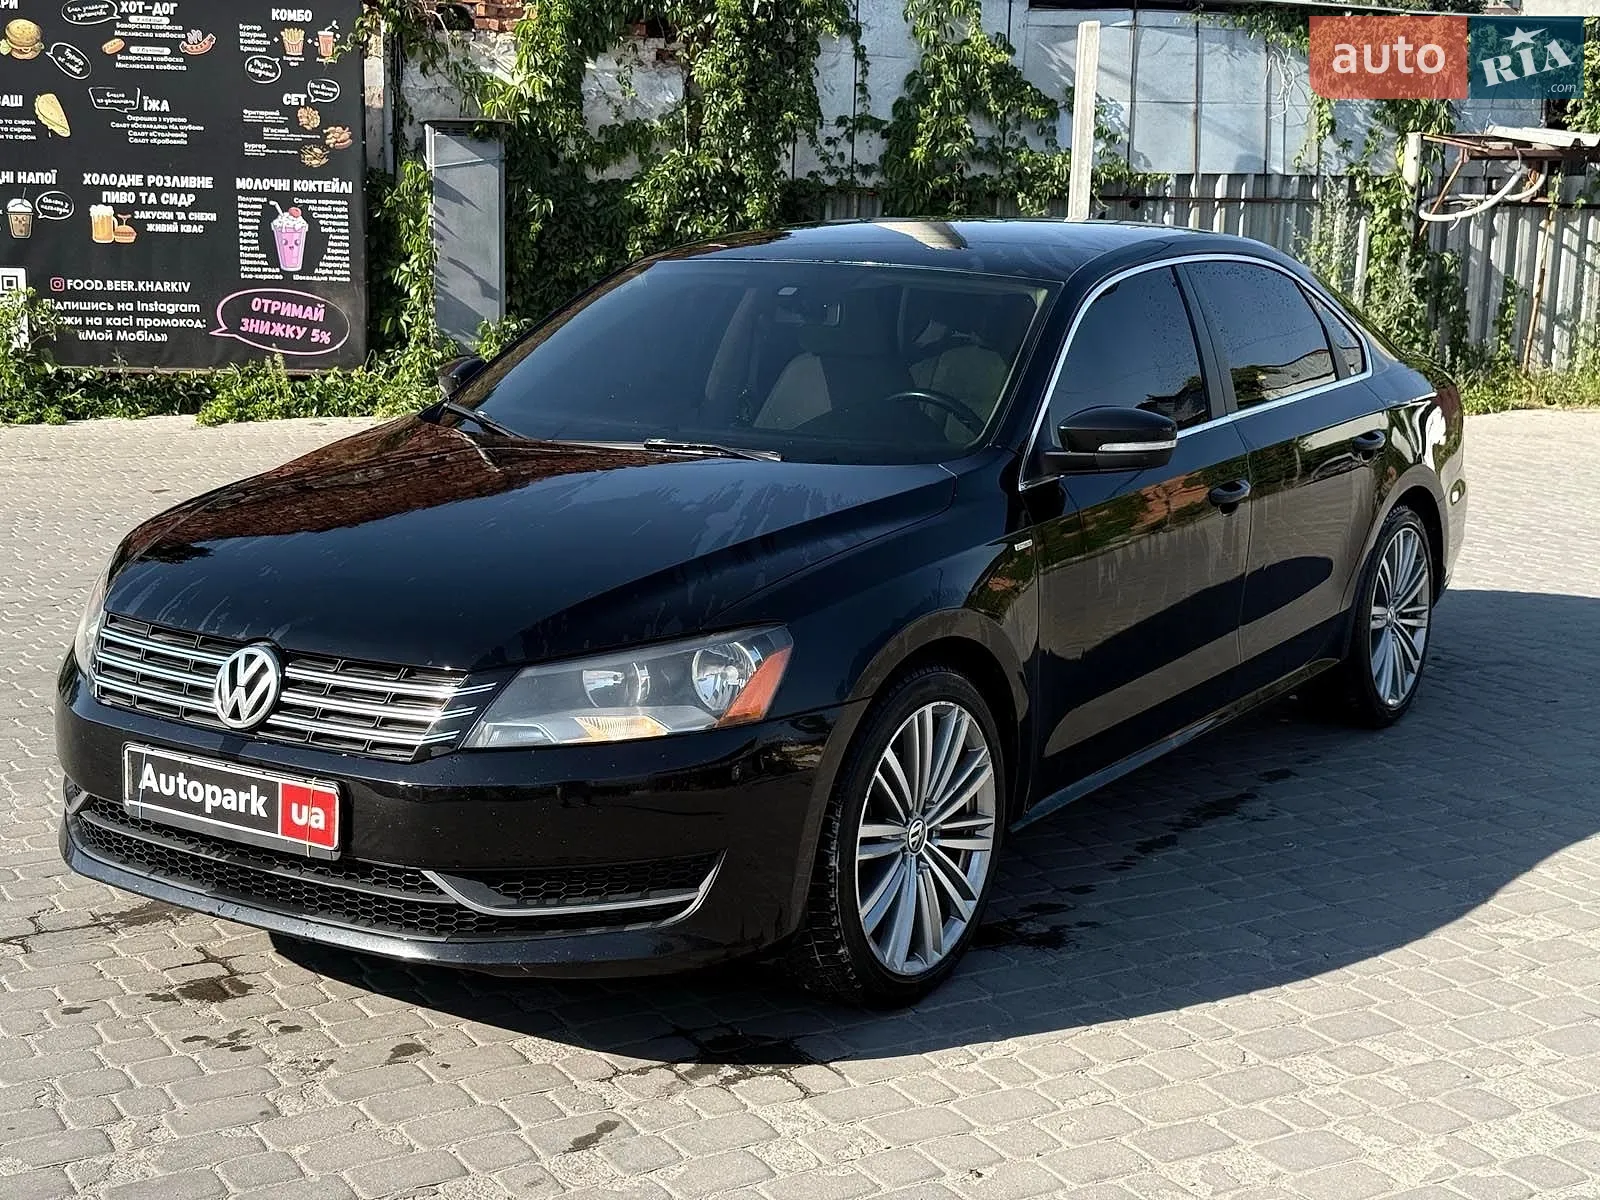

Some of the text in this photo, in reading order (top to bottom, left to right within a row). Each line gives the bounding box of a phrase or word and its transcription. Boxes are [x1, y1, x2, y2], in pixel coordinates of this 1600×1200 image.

[120, 1, 178, 16] ХОТ-ДОГ
[271, 8, 313, 22] КОМБО
[115, 62, 155, 70] Мисливська
[143, 96, 170, 112] ЇЖА
[282, 92, 307, 106] СЕТ
[126, 114, 157, 123] Окрошка
[18, 169, 58, 184] НАПОЇ
[82, 173, 214, 188] ХОЛОДНЕ РОЗЛИВНЕ
[236, 178, 352, 194] МОЛОЧНІ КОКТЕЙЛІ
[102, 191, 196, 207] ПИВО ТА СИДР
[134, 210, 217, 221] ЗАКУСКИ ТА СНЕКИ
[146, 222, 204, 233] ЖИВИЙ КВАС
[66, 279, 191, 293] FOOD.BEER.KHARKIV
[117, 302, 134, 312] на
[137, 300, 200, 314] Instagram
[251, 297, 326, 322] ОТРИМАЙ
[85, 317, 103, 326] на
[105, 315, 134, 327] касі
[136, 318, 206, 329] промокод:
[79, 329, 168, 342] «Мой Мобіль»
[240, 318, 332, 345] ЗНИЖКУ 5%
[138, 762, 326, 830] Autopark ua
